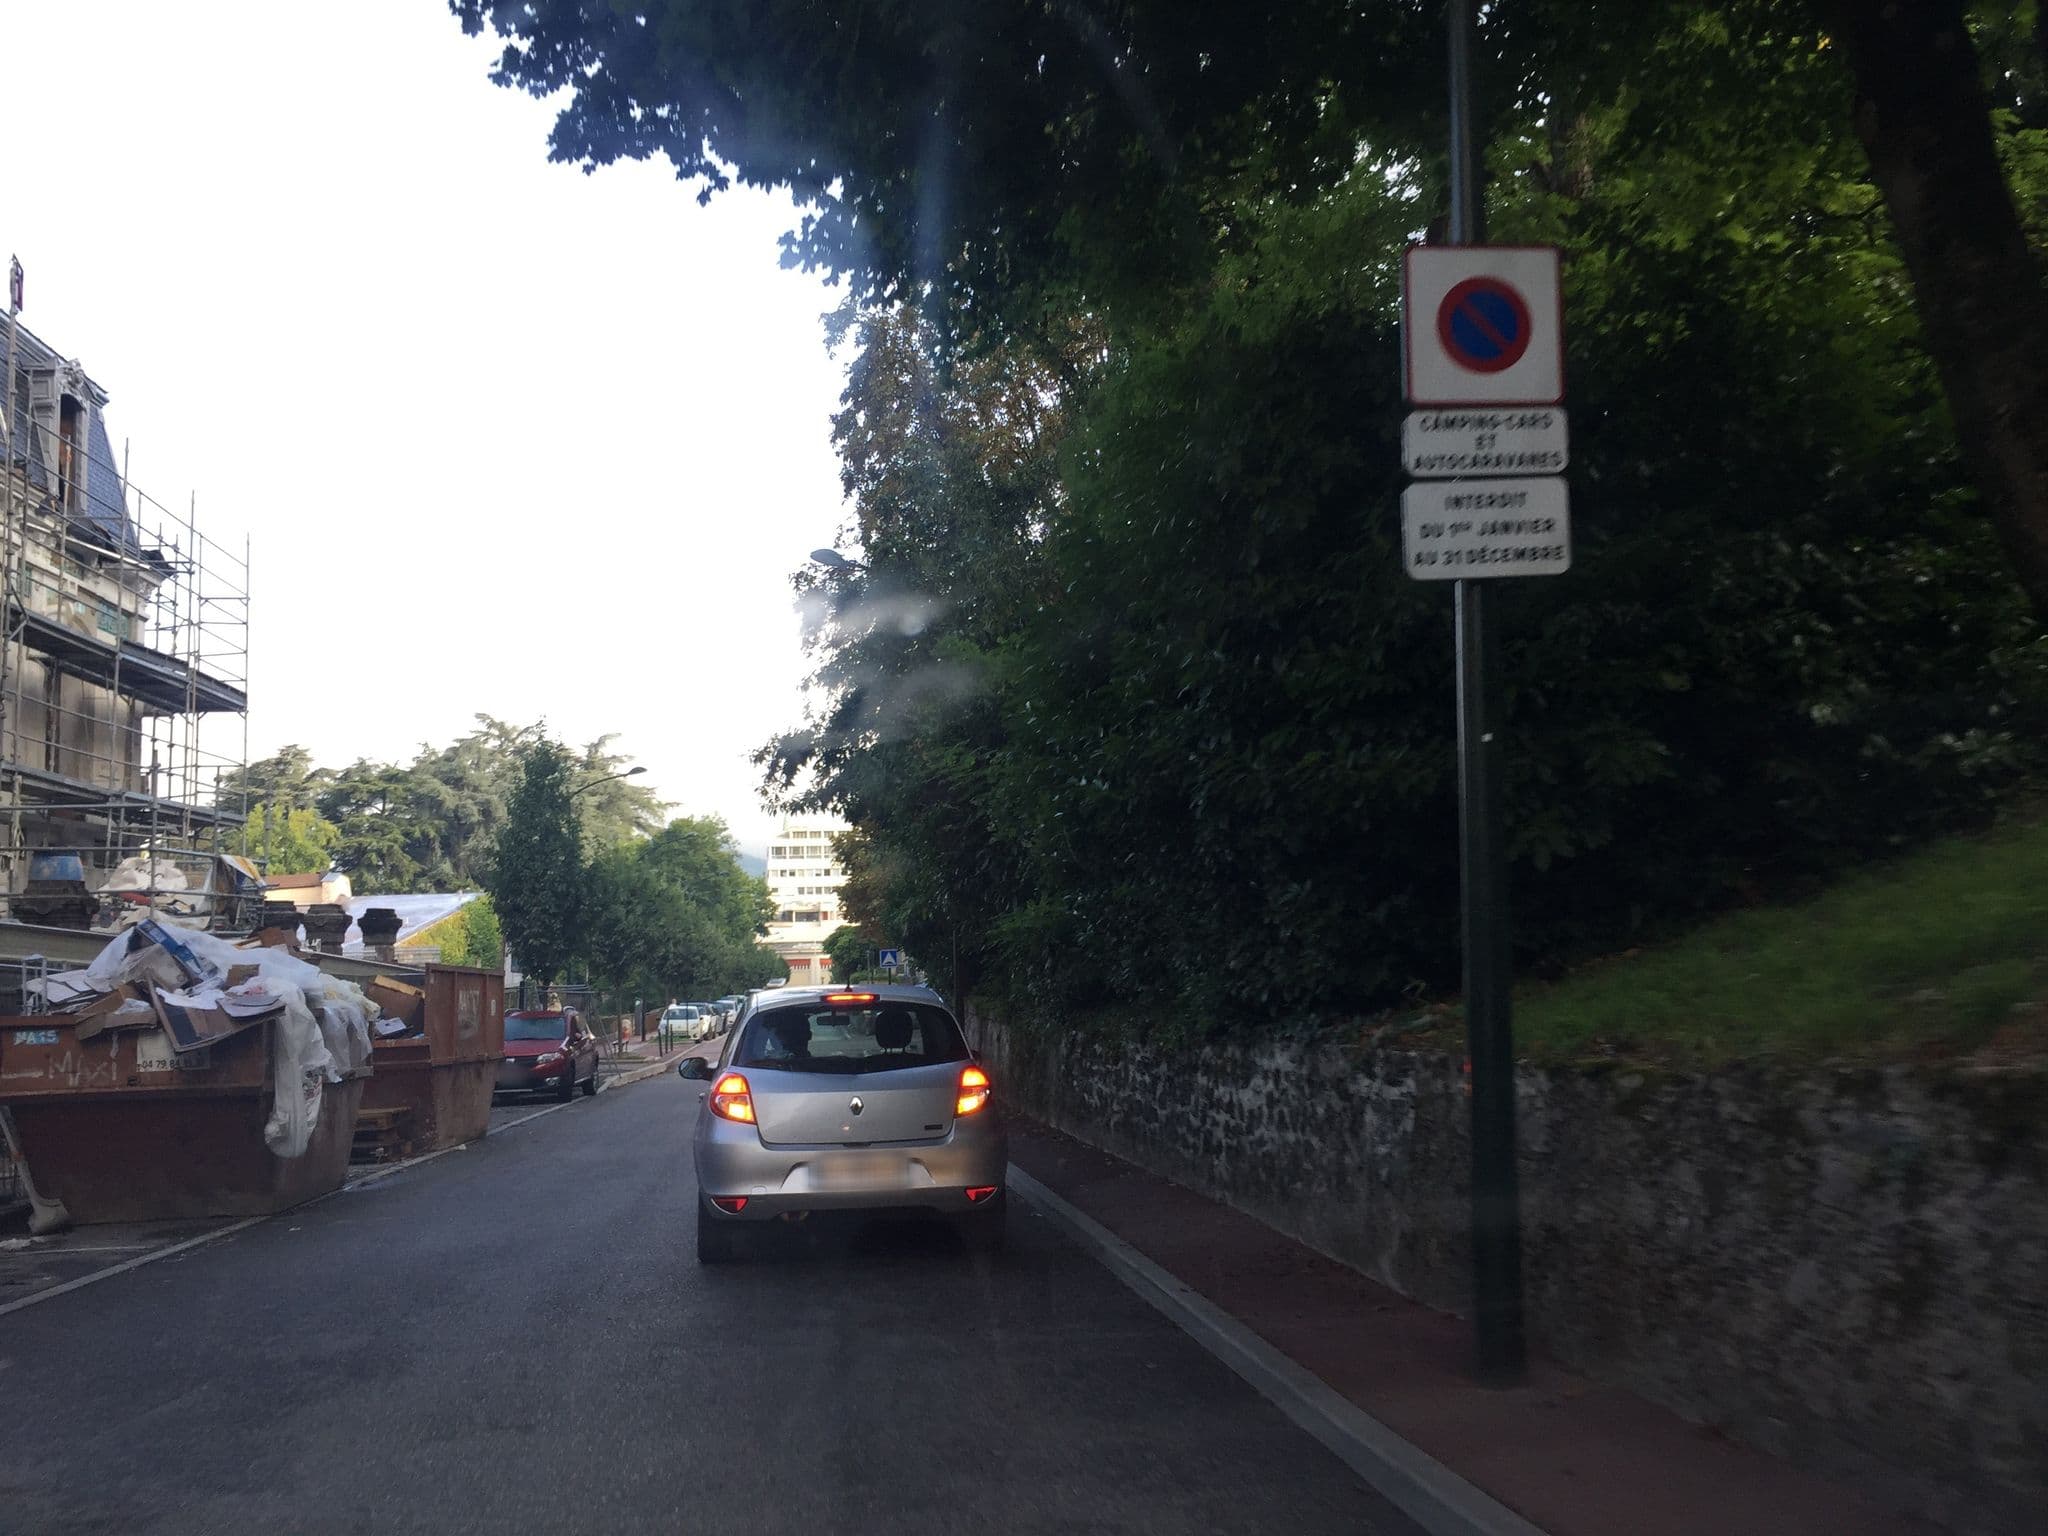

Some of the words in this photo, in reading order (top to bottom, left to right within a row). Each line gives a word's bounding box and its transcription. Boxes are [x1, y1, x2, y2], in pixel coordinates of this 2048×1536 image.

[1475, 434, 1496, 450] ET
[1445, 492, 1527, 510] INTERDIT
[1420, 523, 1445, 539] DU
[1477, 518, 1556, 536] JANVIER
[1414, 551, 1439, 567] AU
[1441, 550, 1463, 566] 31
